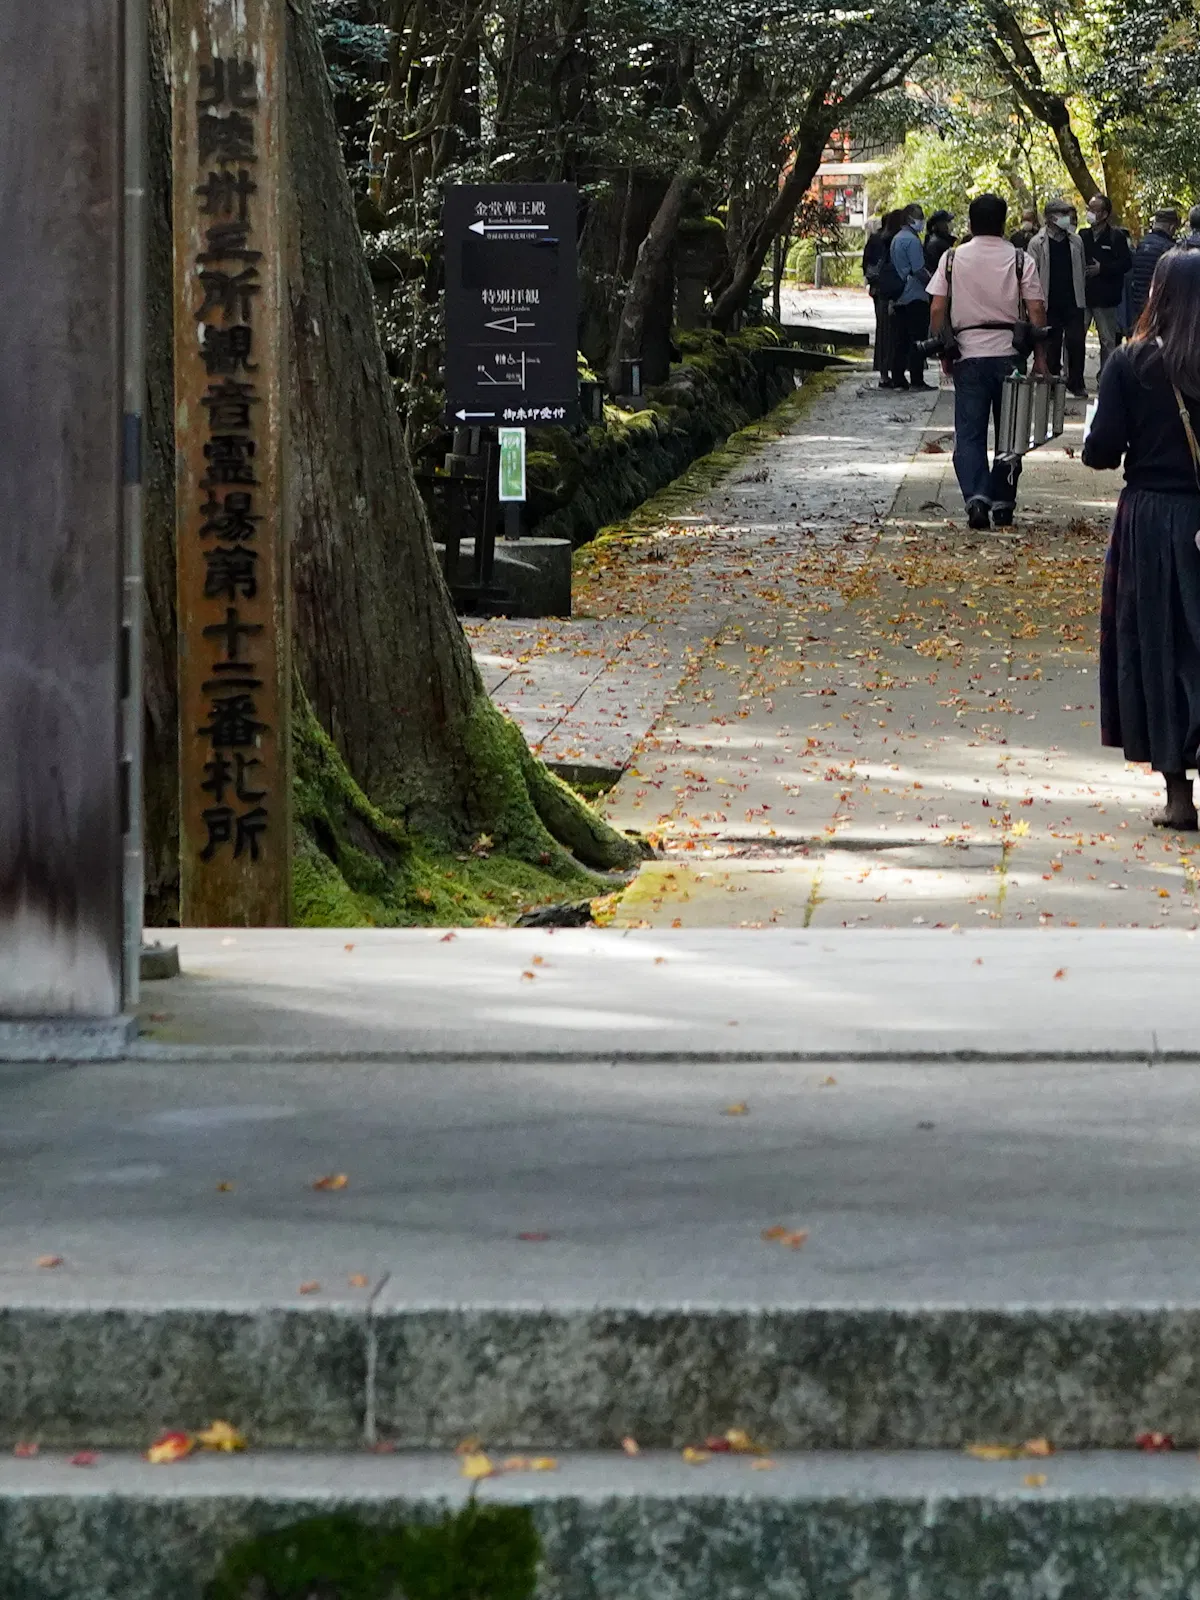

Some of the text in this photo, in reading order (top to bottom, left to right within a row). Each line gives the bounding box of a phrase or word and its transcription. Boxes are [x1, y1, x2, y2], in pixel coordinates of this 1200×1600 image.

[475, 201, 547, 216] 金堂華王殿
[481, 289, 540, 304] 特別拝観
[502, 406, 567, 421] 御朱印受付
